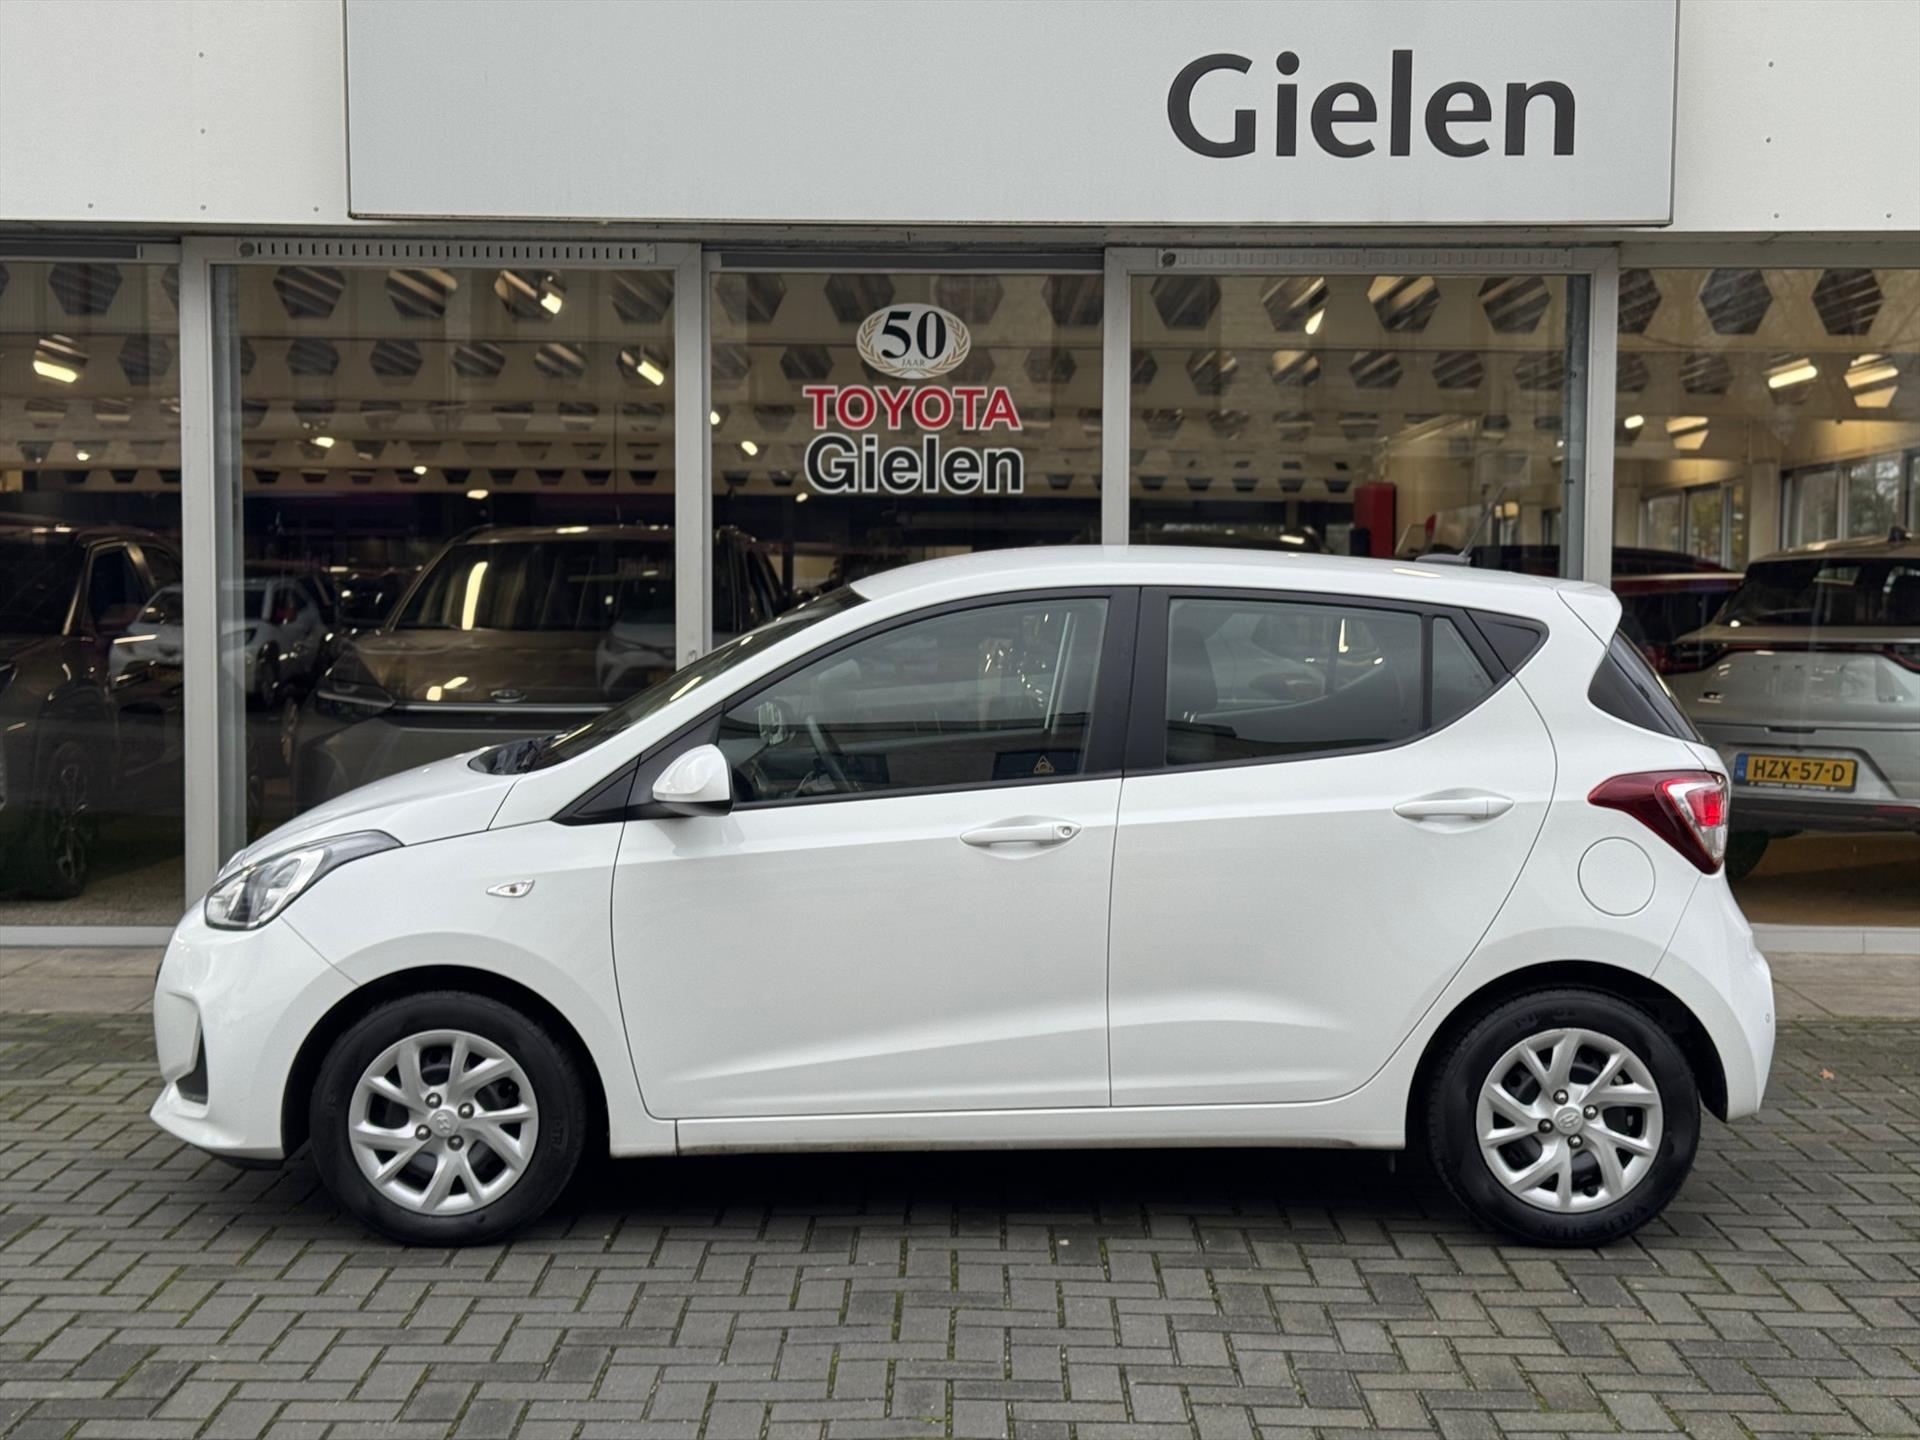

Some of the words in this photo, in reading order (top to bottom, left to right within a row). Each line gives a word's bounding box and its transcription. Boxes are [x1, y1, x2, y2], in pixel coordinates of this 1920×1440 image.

[1167, 49, 1576, 158] Gielen
[881, 310, 947, 360] 50
[901, 359, 925, 368] JAAR
[803, 385, 1023, 431] TOYOTA
[804, 432, 1024, 494] Gielen
[1753, 759, 1846, 782] HZX-57-D
